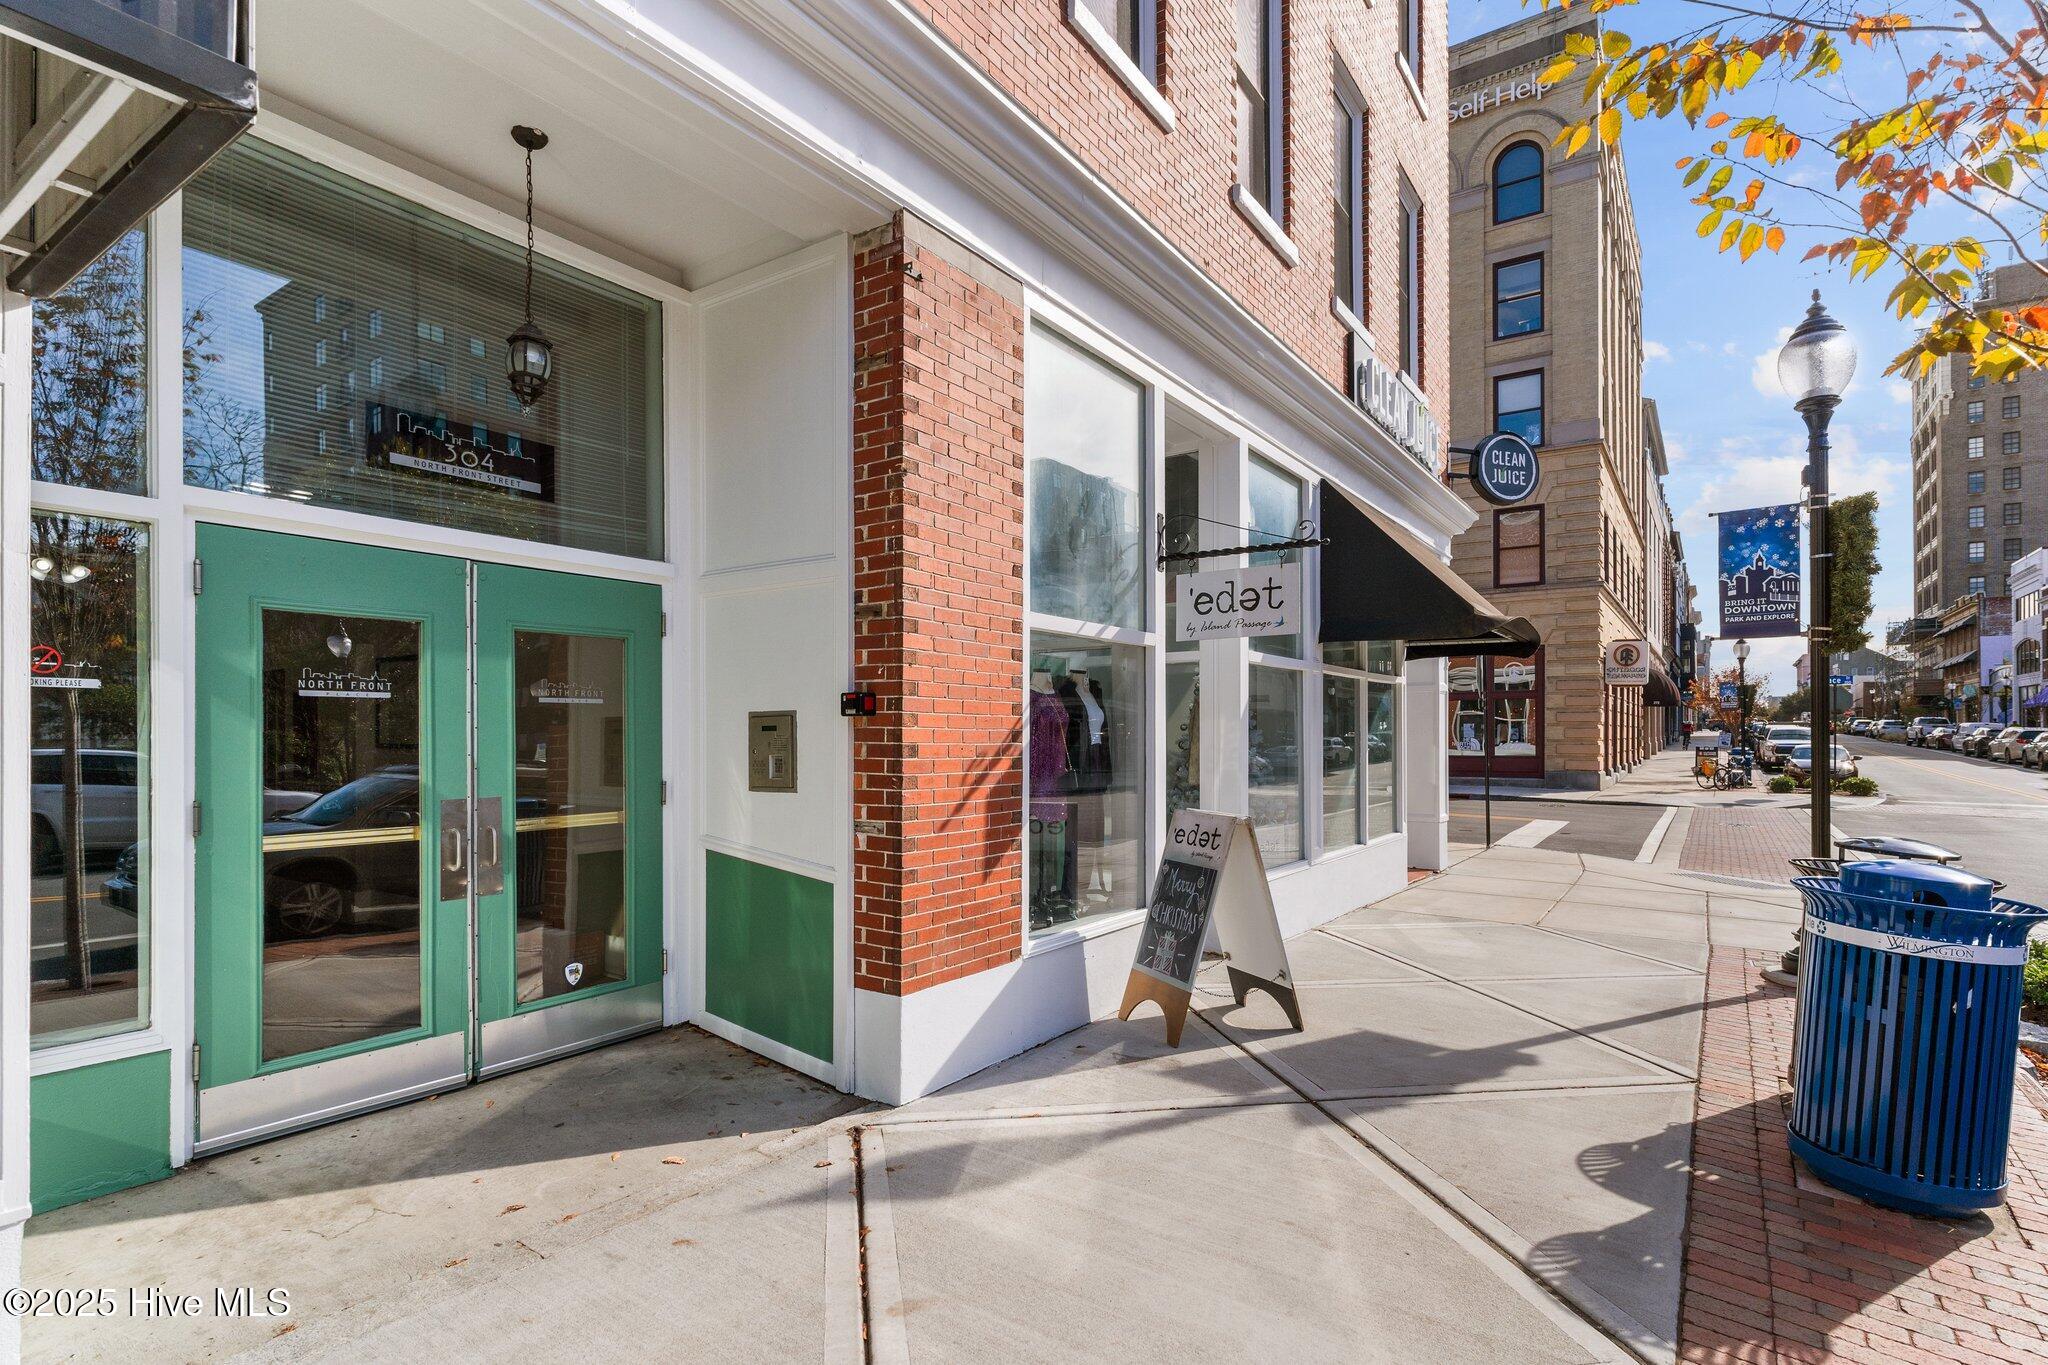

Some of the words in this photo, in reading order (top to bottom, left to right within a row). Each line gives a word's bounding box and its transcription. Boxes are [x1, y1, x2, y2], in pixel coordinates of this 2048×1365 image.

[1448, 73, 1552, 123] Self-Help
[445, 444, 495, 471] 304
[1492, 450, 1526, 467] CLEAN
[413, 459, 447, 473] NORTH
[452, 467, 483, 480] FRONT
[487, 474, 522, 488] STREET
[1492, 468, 1526, 486] JUICE
[1724, 599, 1754, 607] BRING
[1724, 603, 1796, 614] DOWNTOWN
[1186, 622, 1197, 638] by
[1200, 620, 1232, 632] Island
[1234, 618, 1273, 631] Passage
[55, 679, 82, 687] PLEASE
[298, 680, 343, 689] NORTH
[351, 681, 392, 691] FRONT
[538, 689, 570, 697] NORTH
[1166, 867, 1200, 909] Merry
[1886, 935, 1975, 958] WILMINGTON
